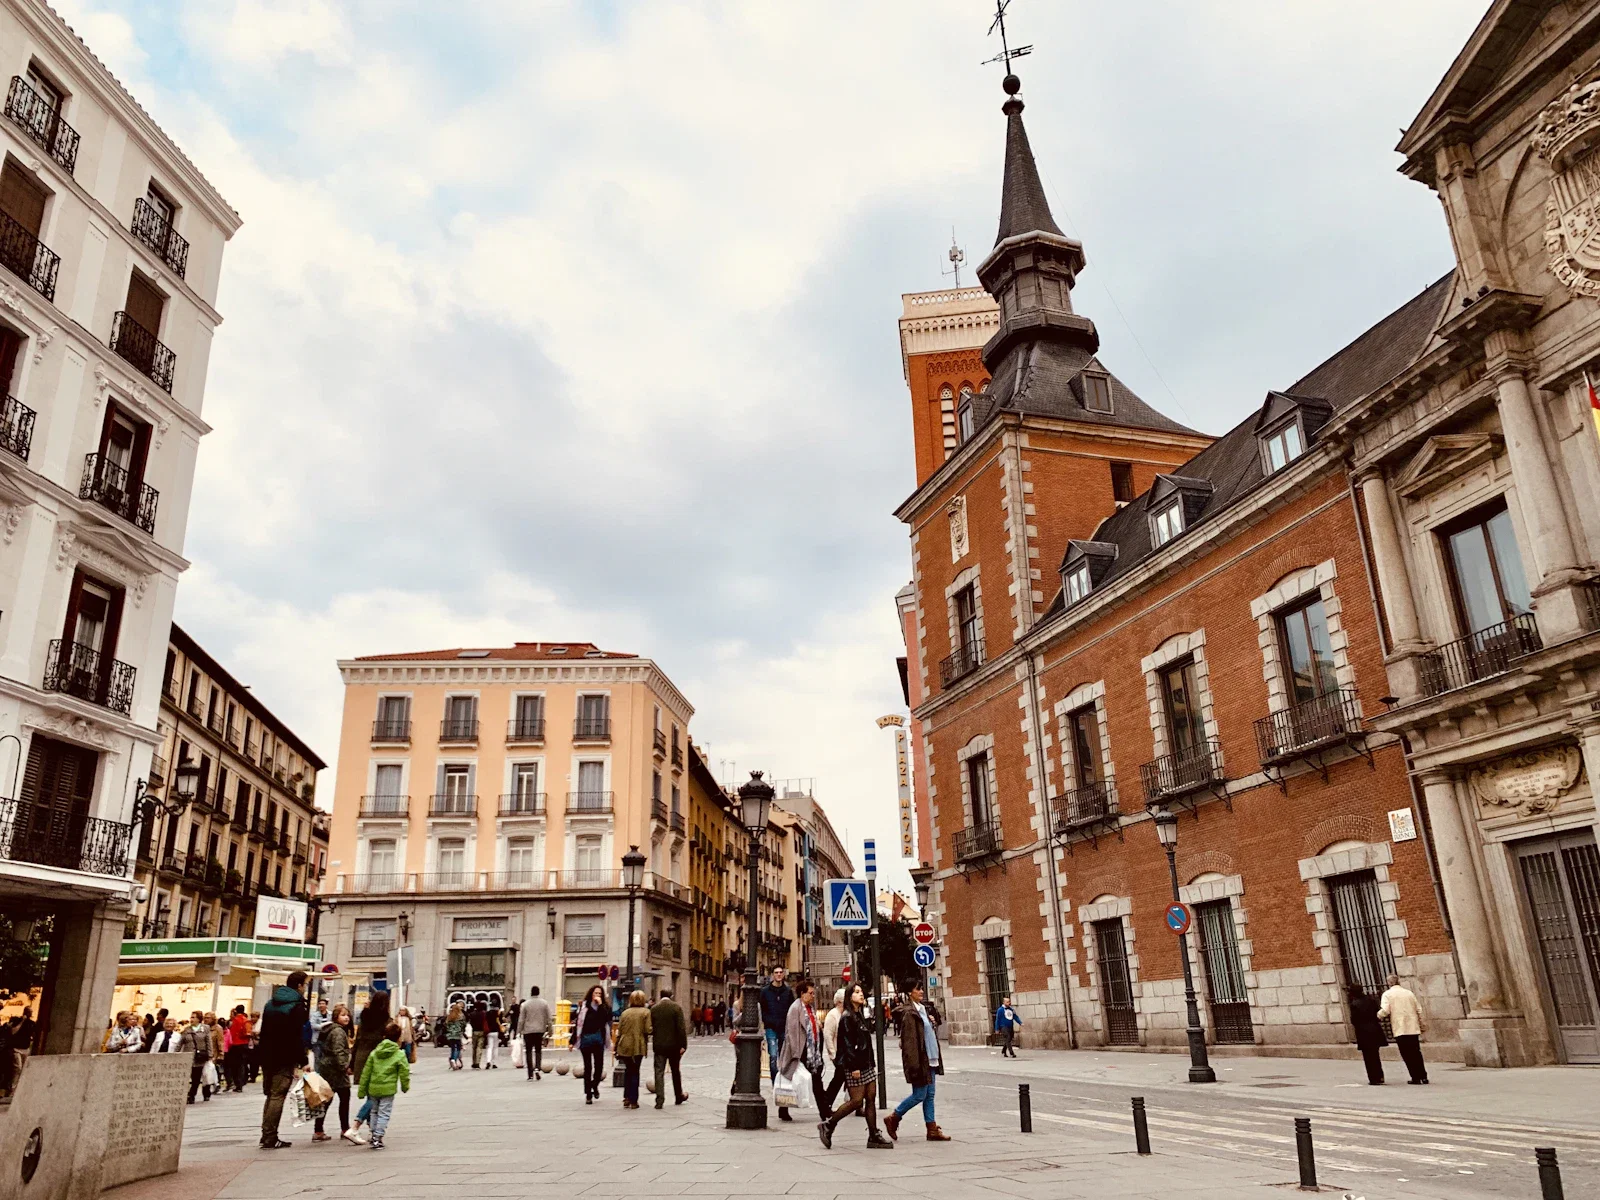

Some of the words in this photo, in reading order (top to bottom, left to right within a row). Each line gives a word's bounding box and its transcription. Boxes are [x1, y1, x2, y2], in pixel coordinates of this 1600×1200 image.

[878, 715, 904, 728] HOTEL
[897, 733, 908, 787] PLAZA
[900, 798, 912, 855] MAYOR
[461, 921, 502, 929] PROPYME
